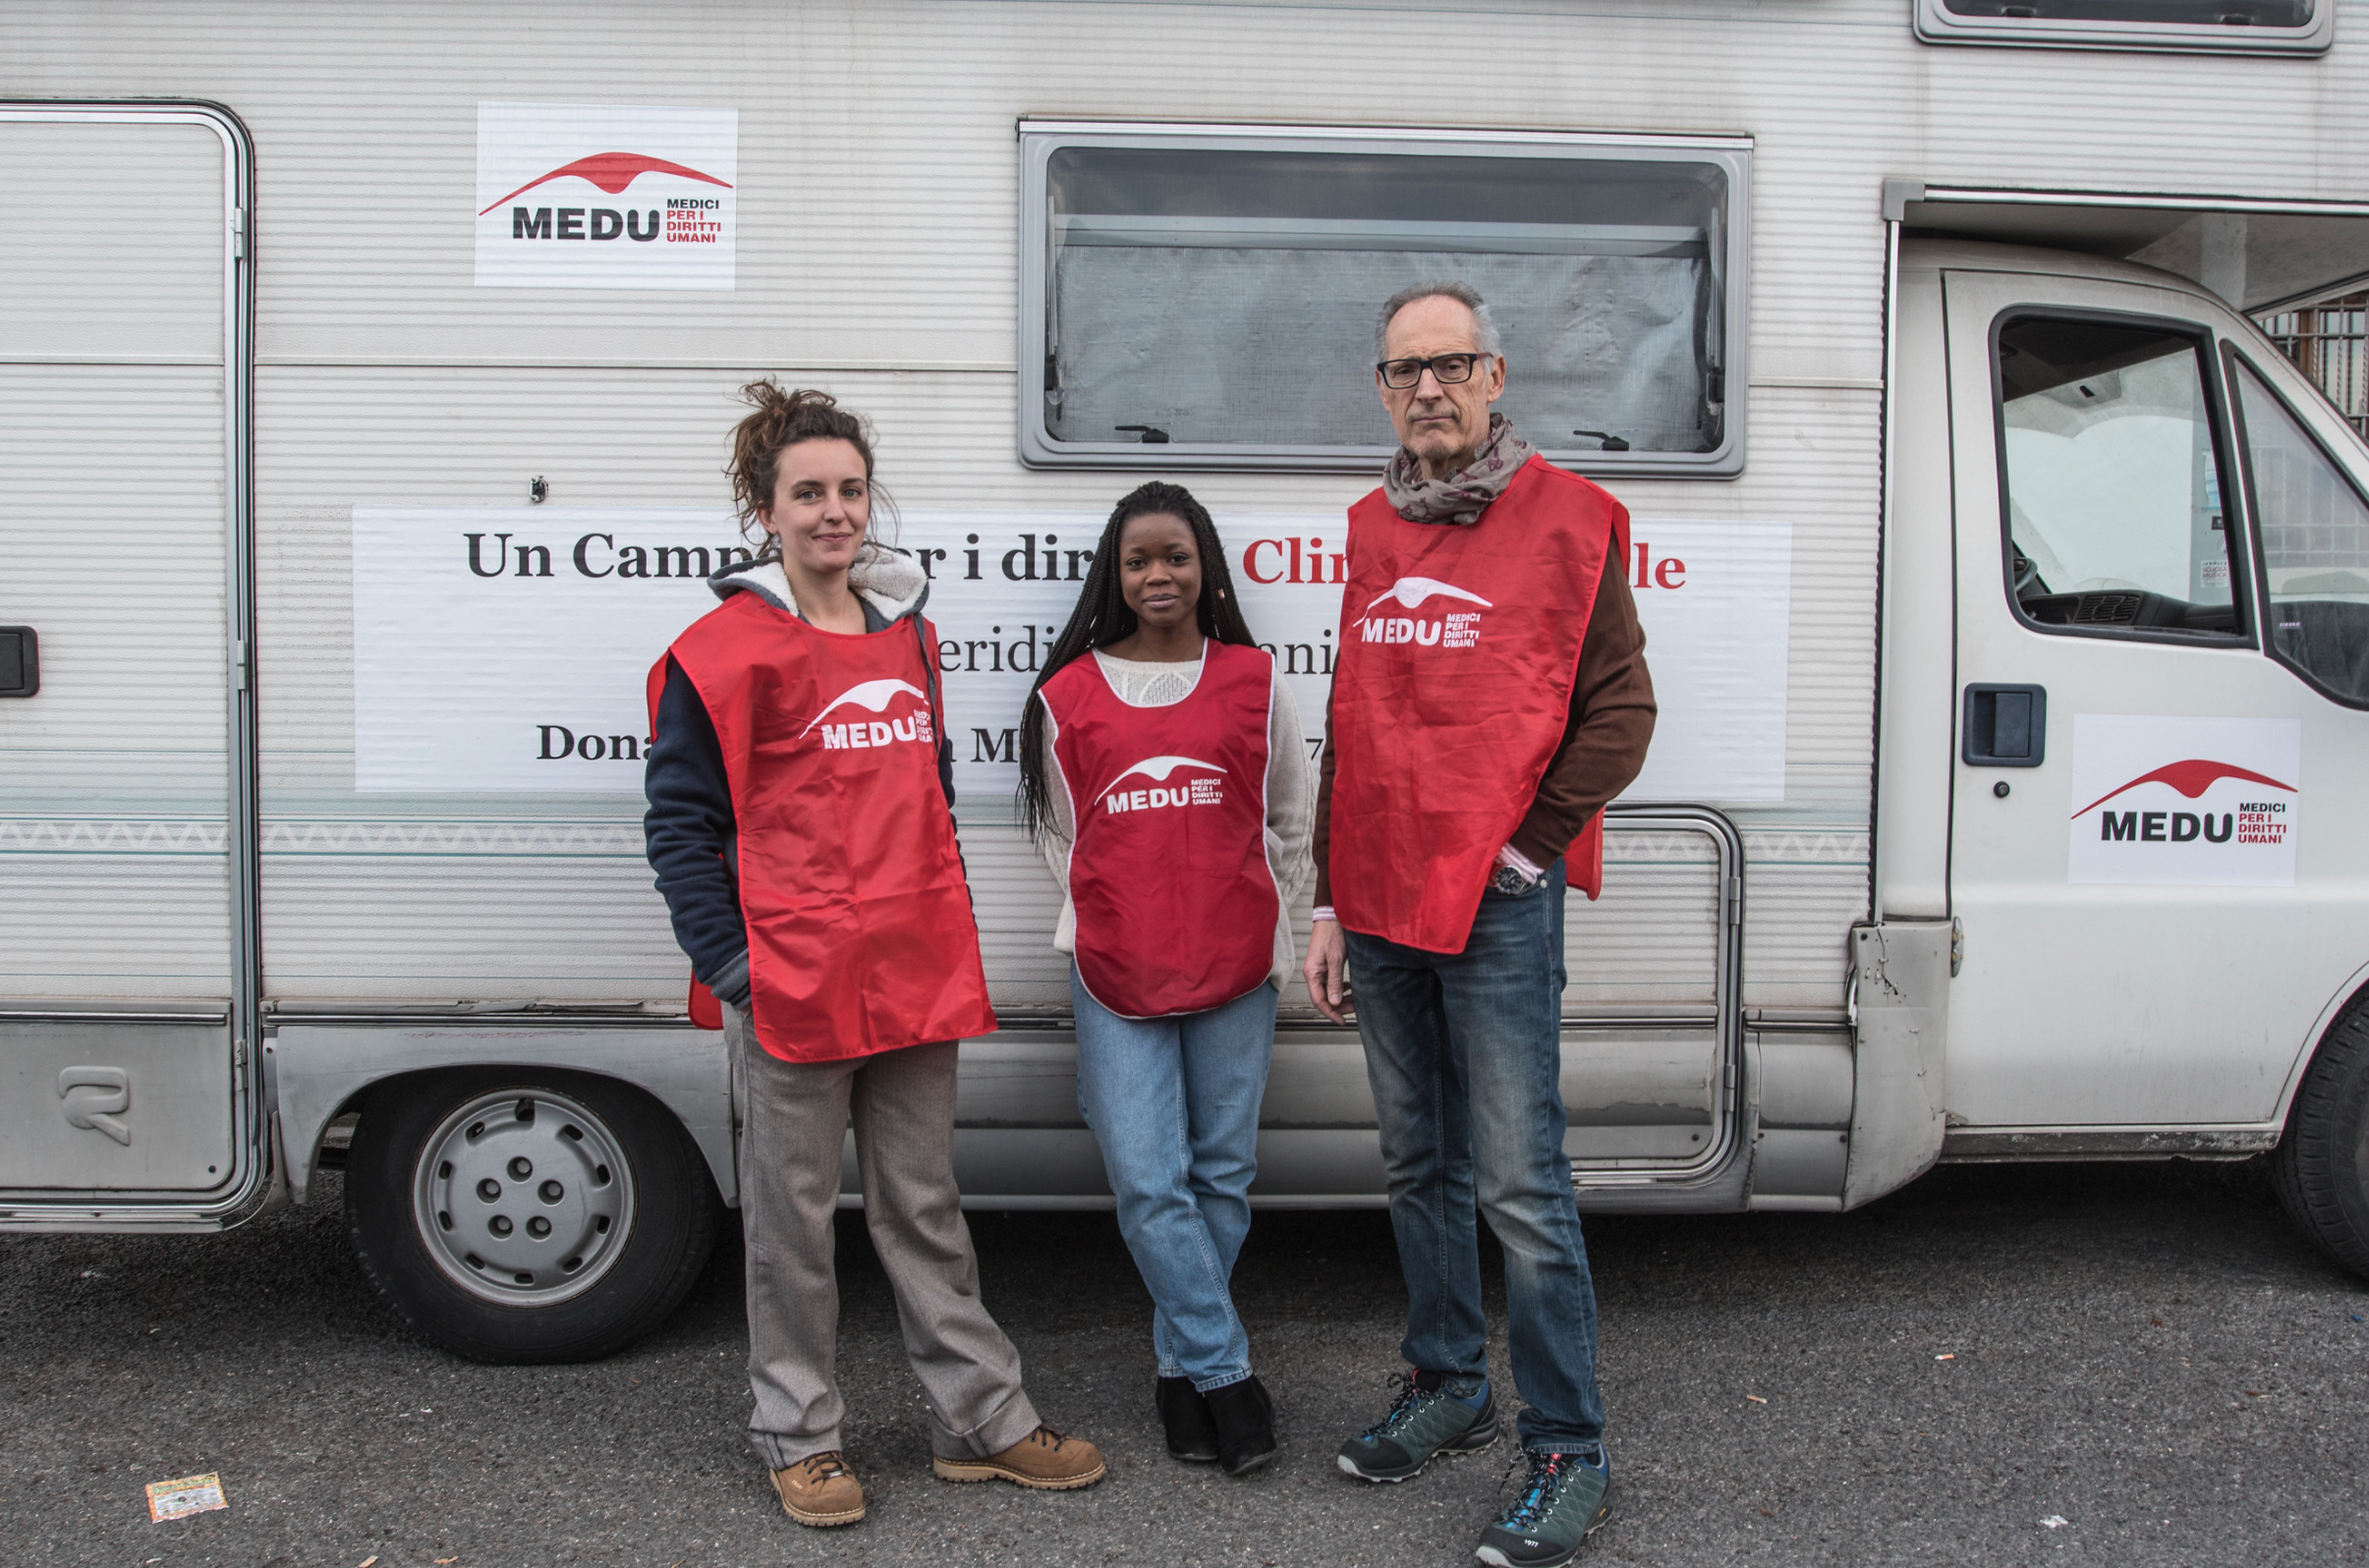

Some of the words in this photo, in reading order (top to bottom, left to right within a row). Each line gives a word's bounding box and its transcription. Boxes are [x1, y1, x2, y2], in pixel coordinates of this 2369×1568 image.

[666, 198, 719, 209] MEDICI
[666, 210, 694, 220] PER
[512, 206, 660, 242] MEDU
[666, 221, 721, 232] DIRITTI
[666, 233, 716, 243] UMANI
[463, 532, 554, 578] Un
[963, 532, 984, 580] i
[1629, 542, 1686, 589] le
[1445, 613, 1481, 623] MEDICI
[1362, 618, 1441, 645] MEDU
[1445, 622, 1464, 631] PER
[1443, 630, 1480, 639] DIRITTI
[1442, 639, 1475, 648] UMANI
[821, 715, 917, 750] MEDU
[1106, 786, 1190, 814] MEDU
[2239, 803, 2286, 812] MEDICI
[2238, 812, 2265, 823] PER
[2101, 811, 2233, 843] MEDU
[2238, 823, 2287, 834] DIRITTI
[2238, 834, 2283, 844] UMANI
